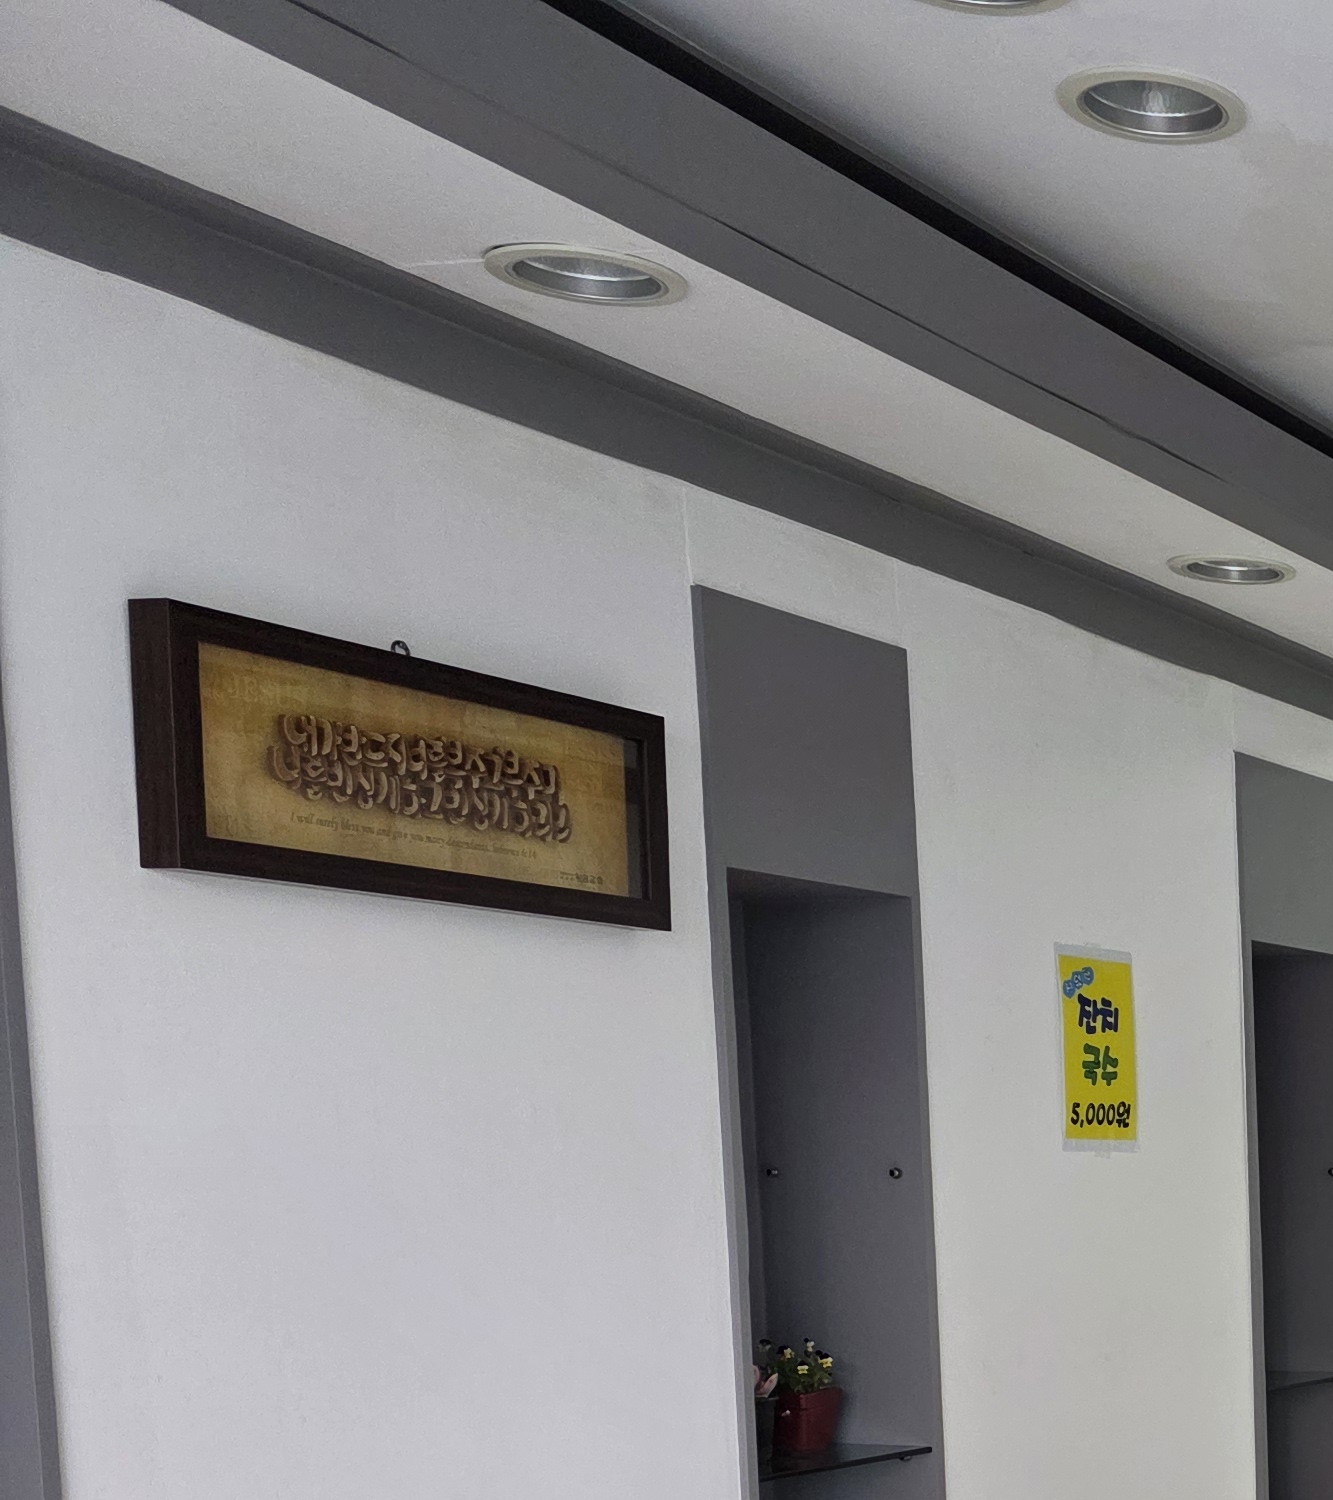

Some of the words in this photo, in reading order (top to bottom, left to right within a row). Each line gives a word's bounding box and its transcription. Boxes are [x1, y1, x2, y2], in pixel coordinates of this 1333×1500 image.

[1078, 993, 1119, 1034] 잔치
[1082, 1043, 1119, 1086] 국수
[1070, 1101, 1131, 1128] 5,000원
